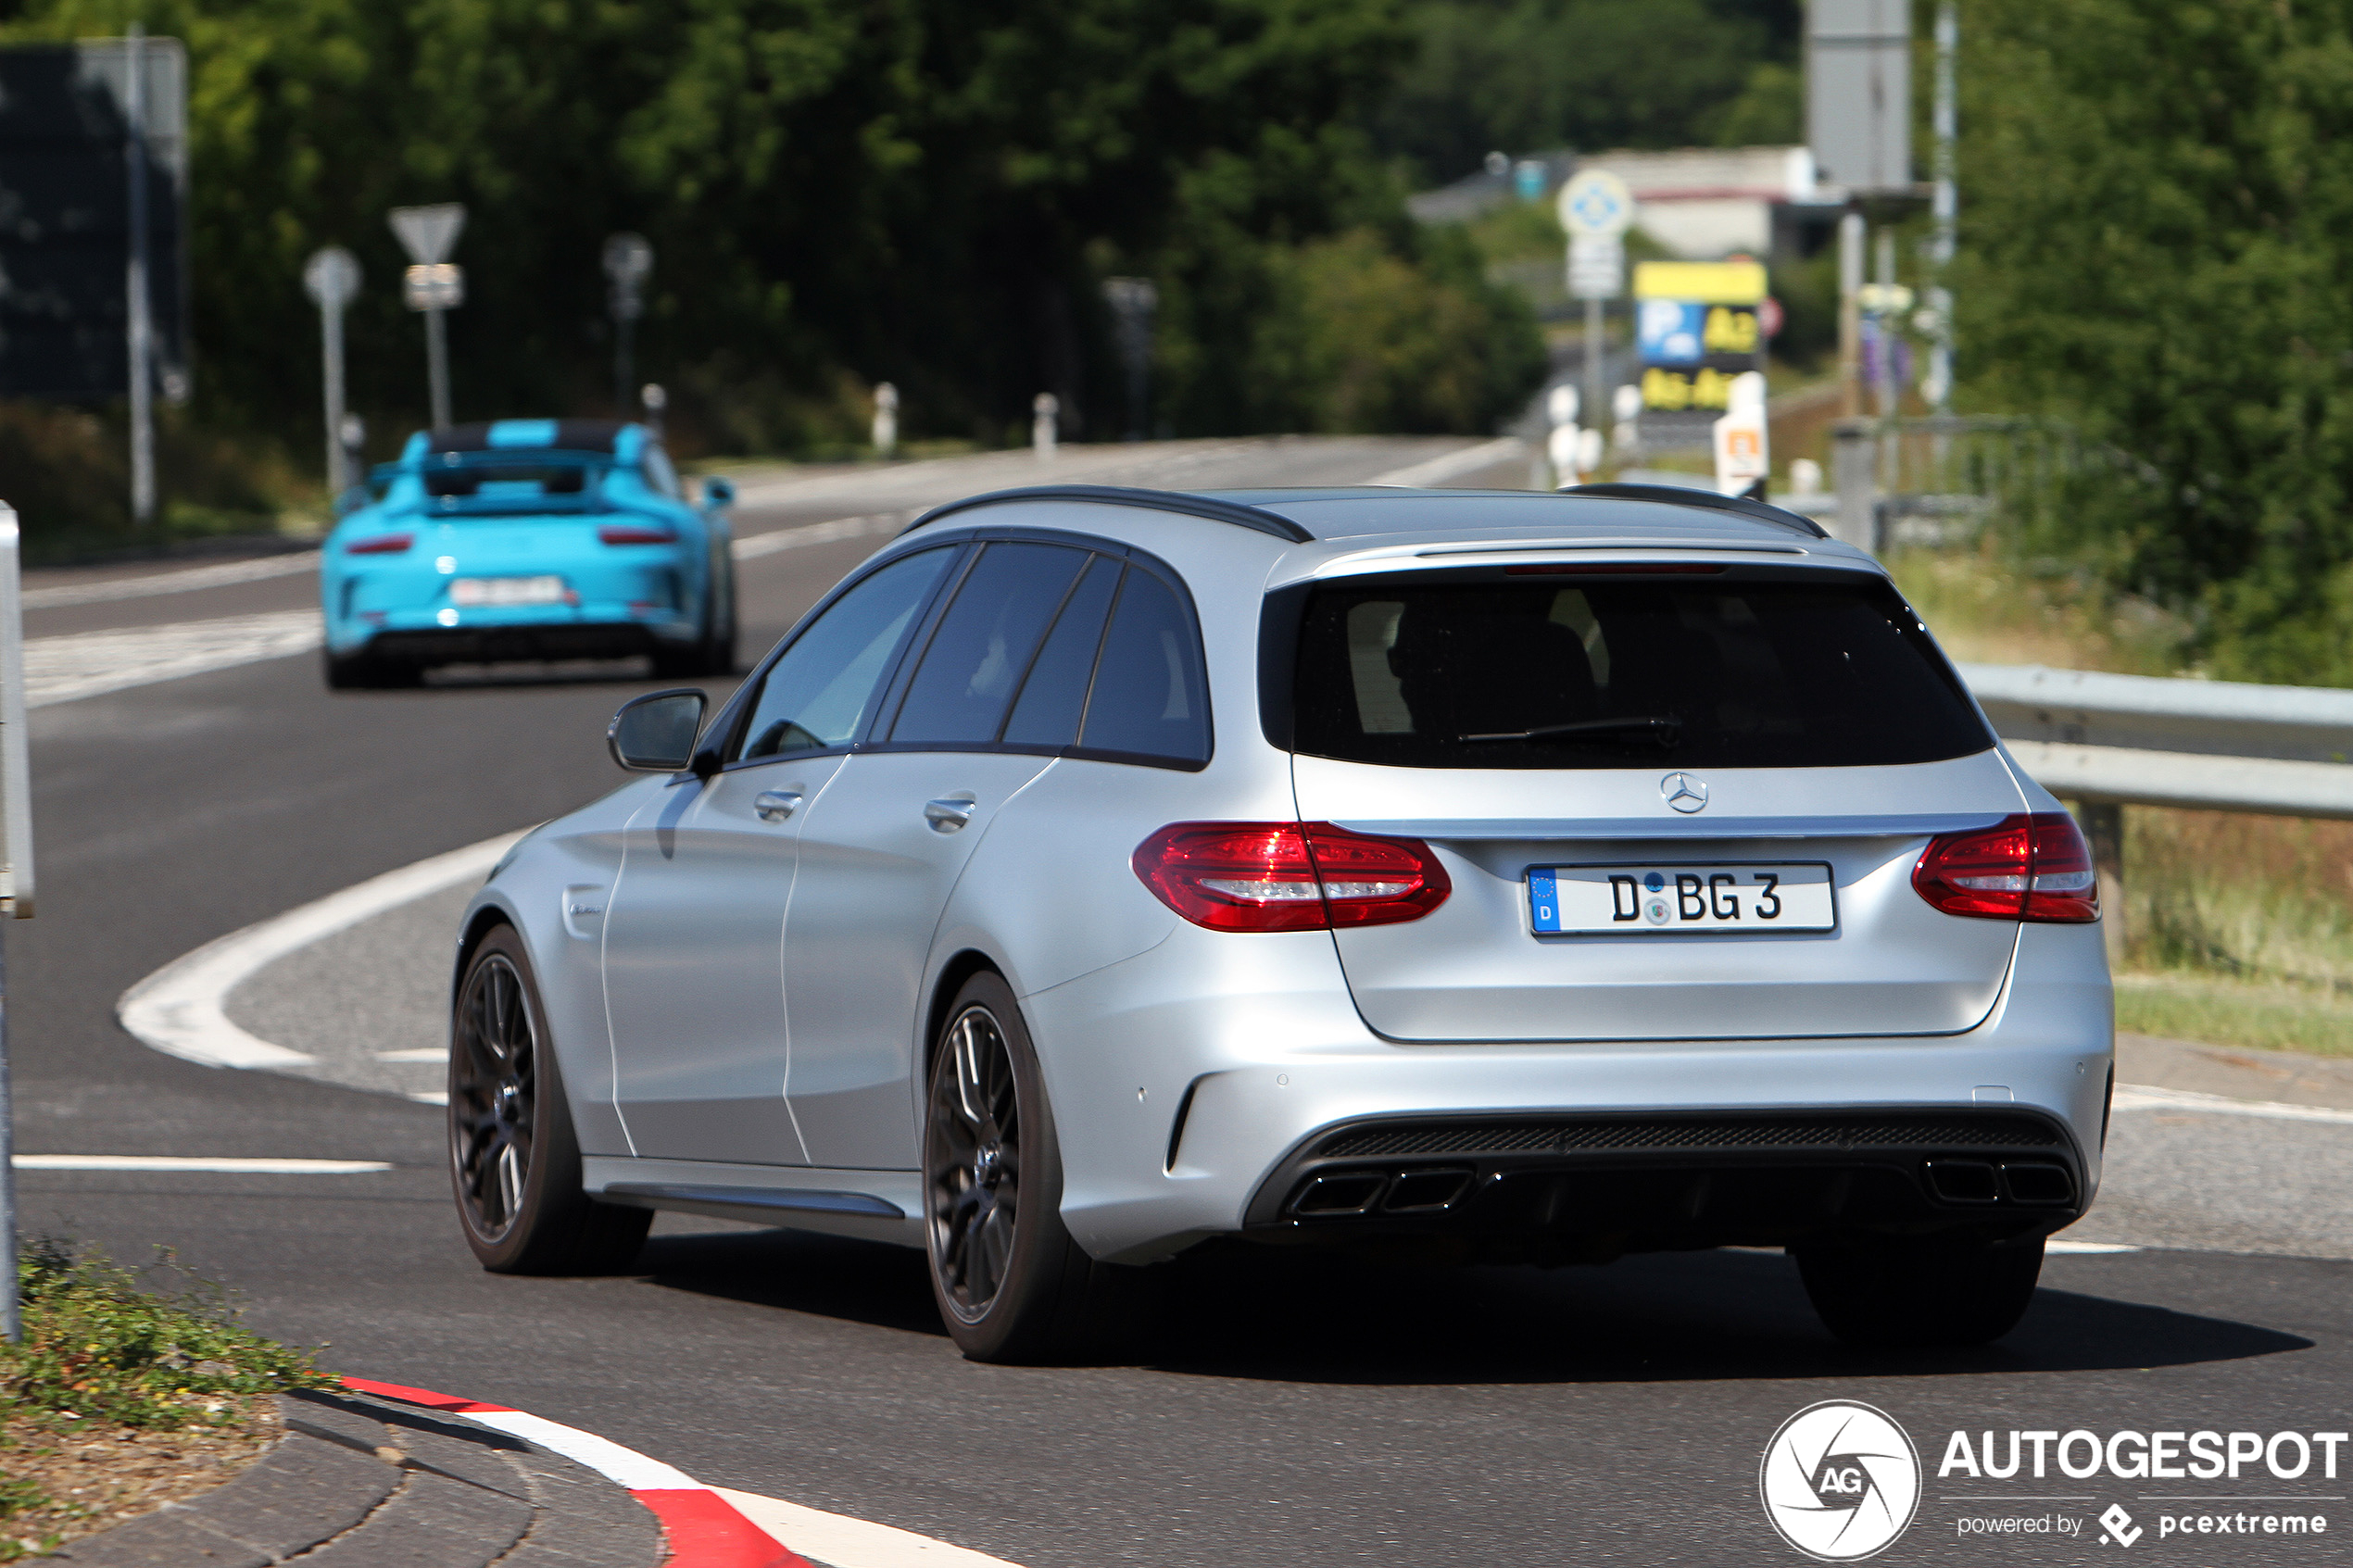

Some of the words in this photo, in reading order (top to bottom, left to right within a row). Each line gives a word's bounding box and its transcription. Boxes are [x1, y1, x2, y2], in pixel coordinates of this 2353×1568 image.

[1540, 906, 1552, 920] D
[1607, 873, 1640, 922] D
[1675, 872, 1740, 921] BG
[1753, 872, 1780, 920] 3
